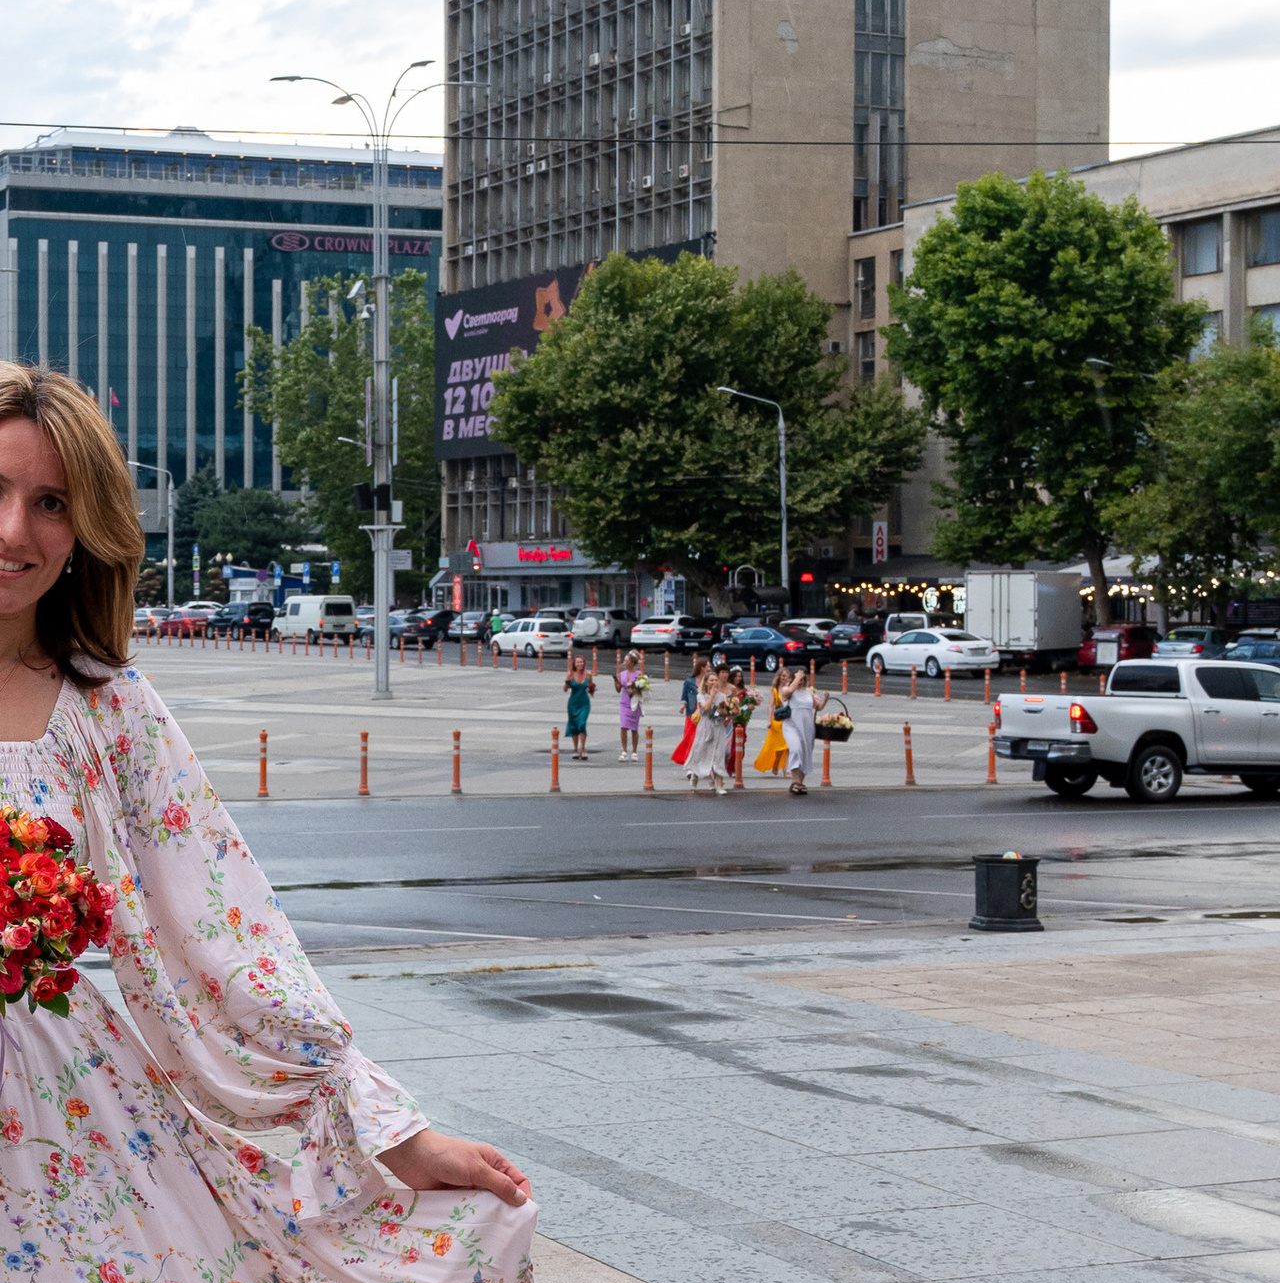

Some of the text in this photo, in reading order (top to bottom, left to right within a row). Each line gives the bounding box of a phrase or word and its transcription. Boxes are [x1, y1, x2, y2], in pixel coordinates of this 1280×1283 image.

[314, 236, 431, 255] CROWN PLAZA
[447, 350, 528, 384] ДВУШК
[444, 386, 466, 416] 12
[442, 419, 455, 441] В
